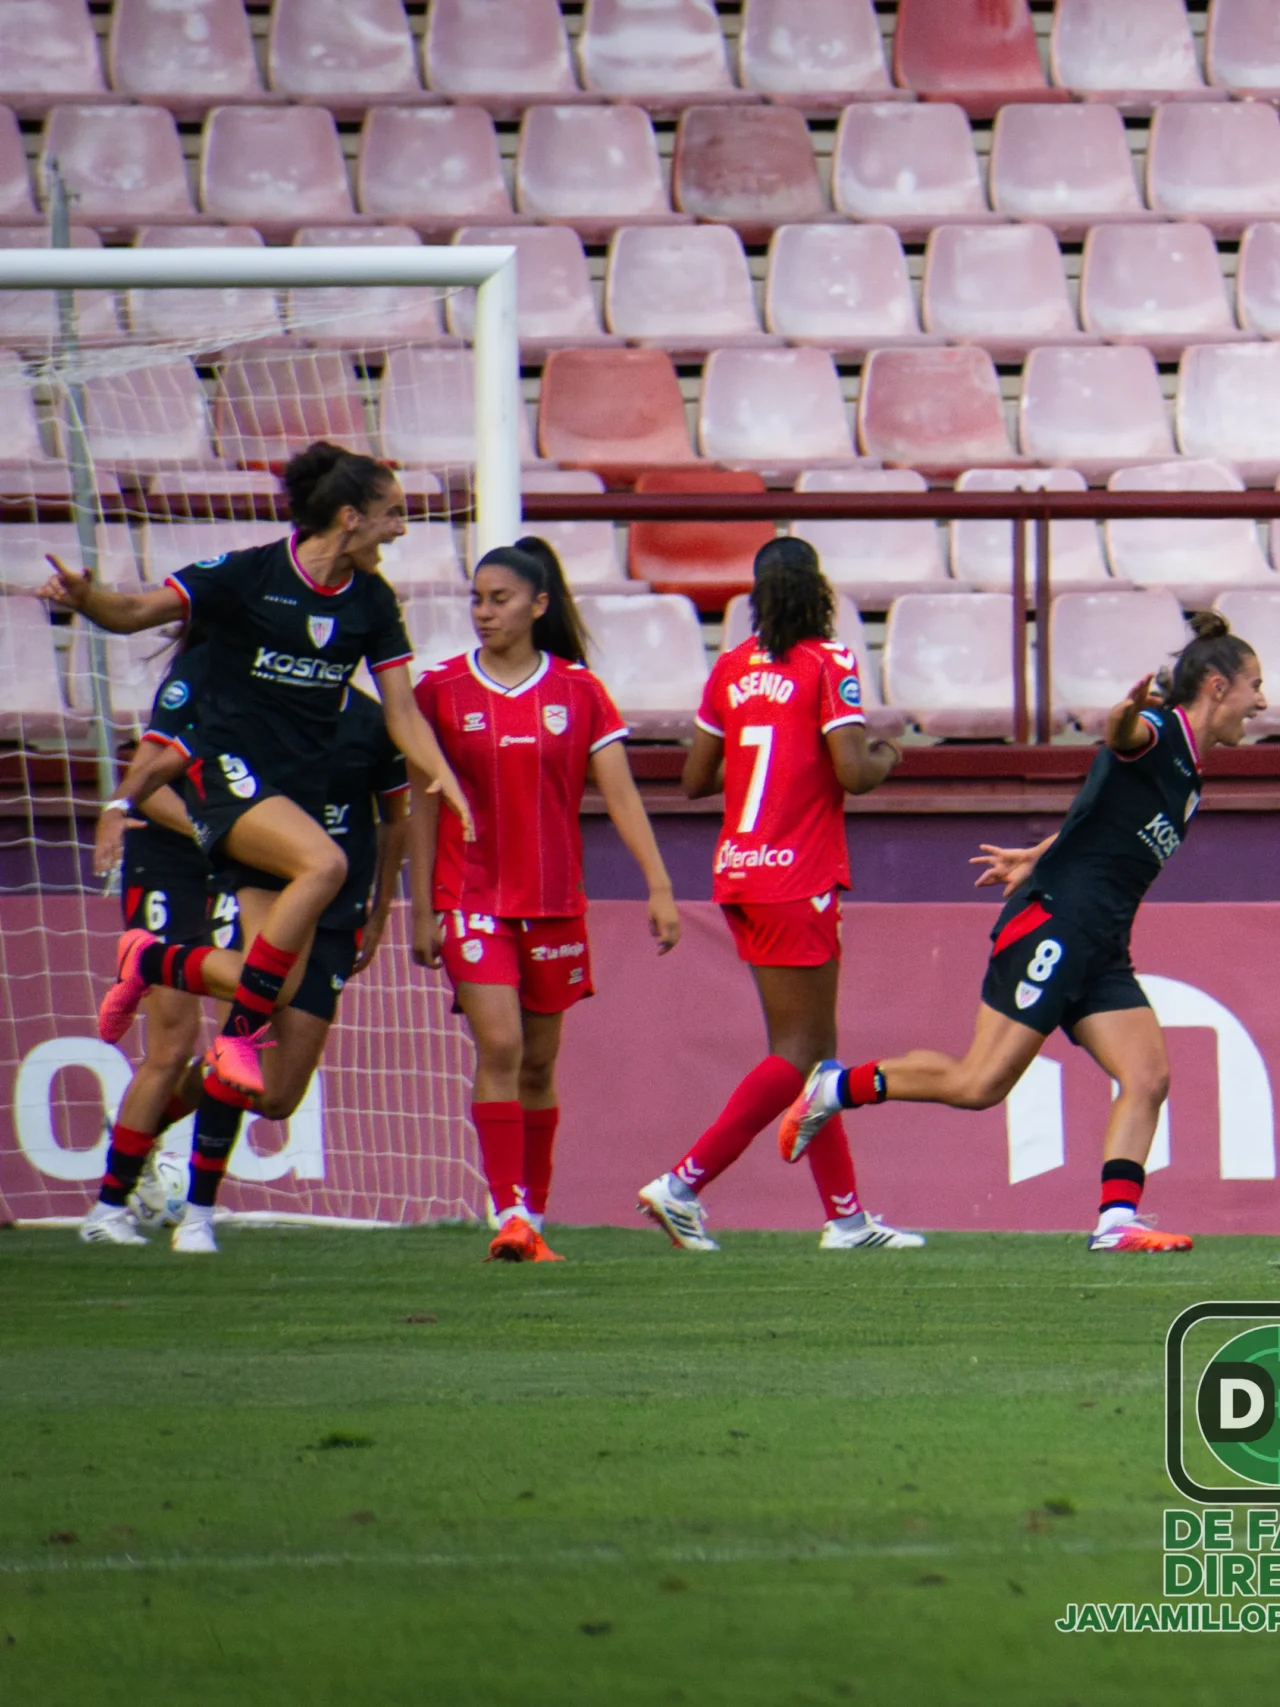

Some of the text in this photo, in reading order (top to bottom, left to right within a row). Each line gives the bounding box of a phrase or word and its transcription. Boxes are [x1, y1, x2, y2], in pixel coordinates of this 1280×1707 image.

[253, 647, 354, 681] kosner
[728, 671, 794, 709] ASENJO
[218, 754, 249, 781] 5
[737, 725, 774, 833] 7
[144, 891, 168, 931] 6
[212, 893, 240, 921] 4
[453, 909, 496, 938] 14
[1027, 939, 1062, 982] 8
